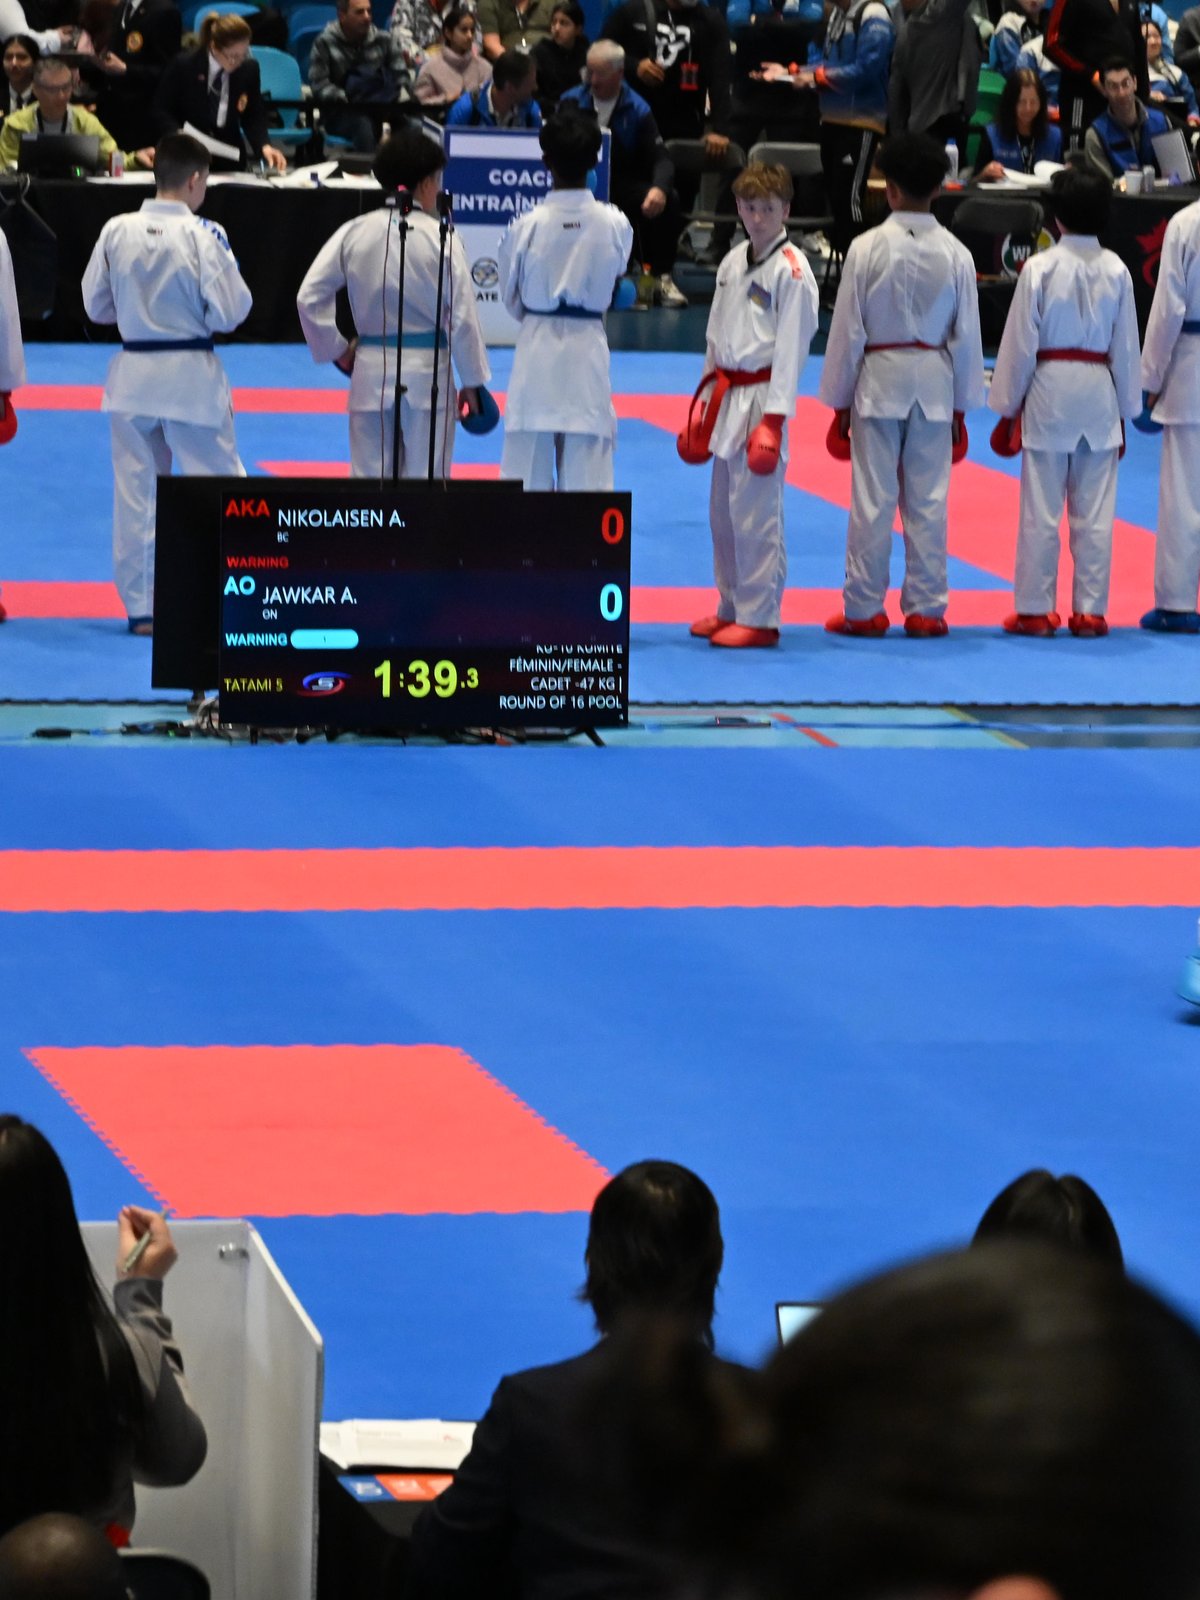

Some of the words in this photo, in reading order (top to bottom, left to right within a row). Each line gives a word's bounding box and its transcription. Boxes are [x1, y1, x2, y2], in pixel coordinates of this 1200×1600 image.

[225, 499, 270, 518] AKA
[278, 509, 383, 527] NIKOLAISEN
[389, 509, 406, 528] A.
[602, 508, 624, 545] 0
[277, 531, 289, 543] BC
[226, 556, 289, 568] WARNING
[223, 575, 256, 595] AO
[262, 586, 336, 605] JAWKAR
[340, 586, 358, 605] A.
[600, 583, 623, 622] 0
[262, 608, 278, 620] ON
[225, 633, 288, 647] WARNING
[509, 656, 614, 673] FÉMININ/FEMALE
[224, 677, 272, 692] TATAMI
[530, 677, 572, 691] CADET
[598, 677, 615, 691] KG
[499, 695, 546, 710] ROUND
[549, 695, 566, 710] OF
[570, 695, 585, 710] 16
[588, 695, 622, 710] POOL
